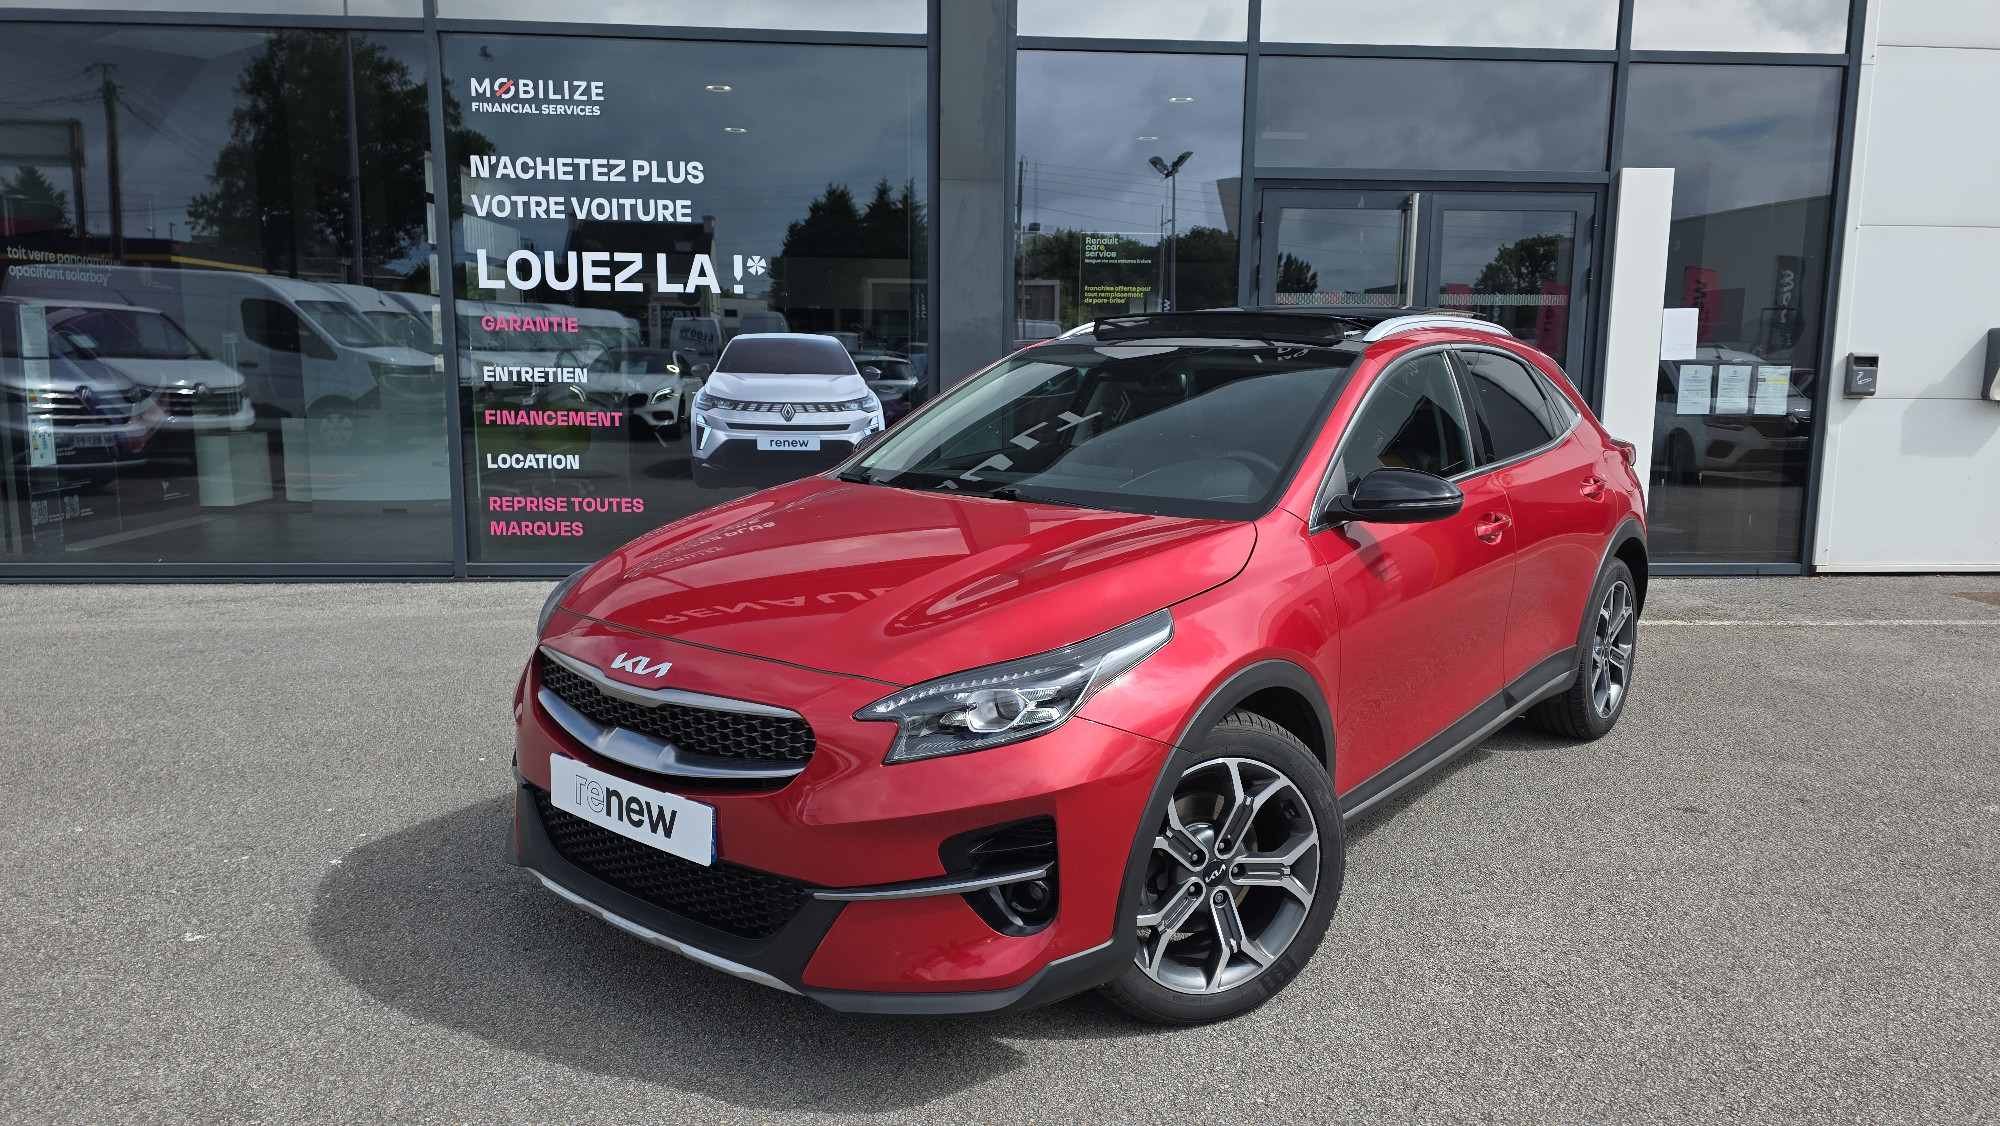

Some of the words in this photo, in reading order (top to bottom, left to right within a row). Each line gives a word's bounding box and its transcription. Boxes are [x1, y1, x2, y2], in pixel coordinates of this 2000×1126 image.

[470, 77, 605, 101] MOBILIZE
[471, 102, 539, 115] FINANCIAL
[541, 103, 601, 117] SERVICES
[470, 154, 626, 182] N'ACHETEZ
[632, 160, 705, 185] PLUS
[471, 194, 566, 219] VOTRE
[571, 197, 692, 223] VOITURE
[1085, 236, 1118, 245] Renault
[6, 244, 27, 260] toit
[28, 249, 55, 263] verre
[57, 253, 121, 271] panoramique
[8, 264, 64, 280] opacifiant
[477, 248, 644, 292] LOUEZ
[656, 253, 721, 294] LA
[482, 316, 579, 333] GARANTIE
[483, 366, 588, 383] ENTRETIEN
[484, 410, 623, 427] FINANCEMENT
[770, 439, 809, 448] renew
[487, 453, 580, 470] LOCATION
[489, 496, 568, 512] REPRISE
[570, 497, 645, 513] TOUTES
[490, 520, 584, 537] MARQUES
[575, 774, 678, 839] renew
